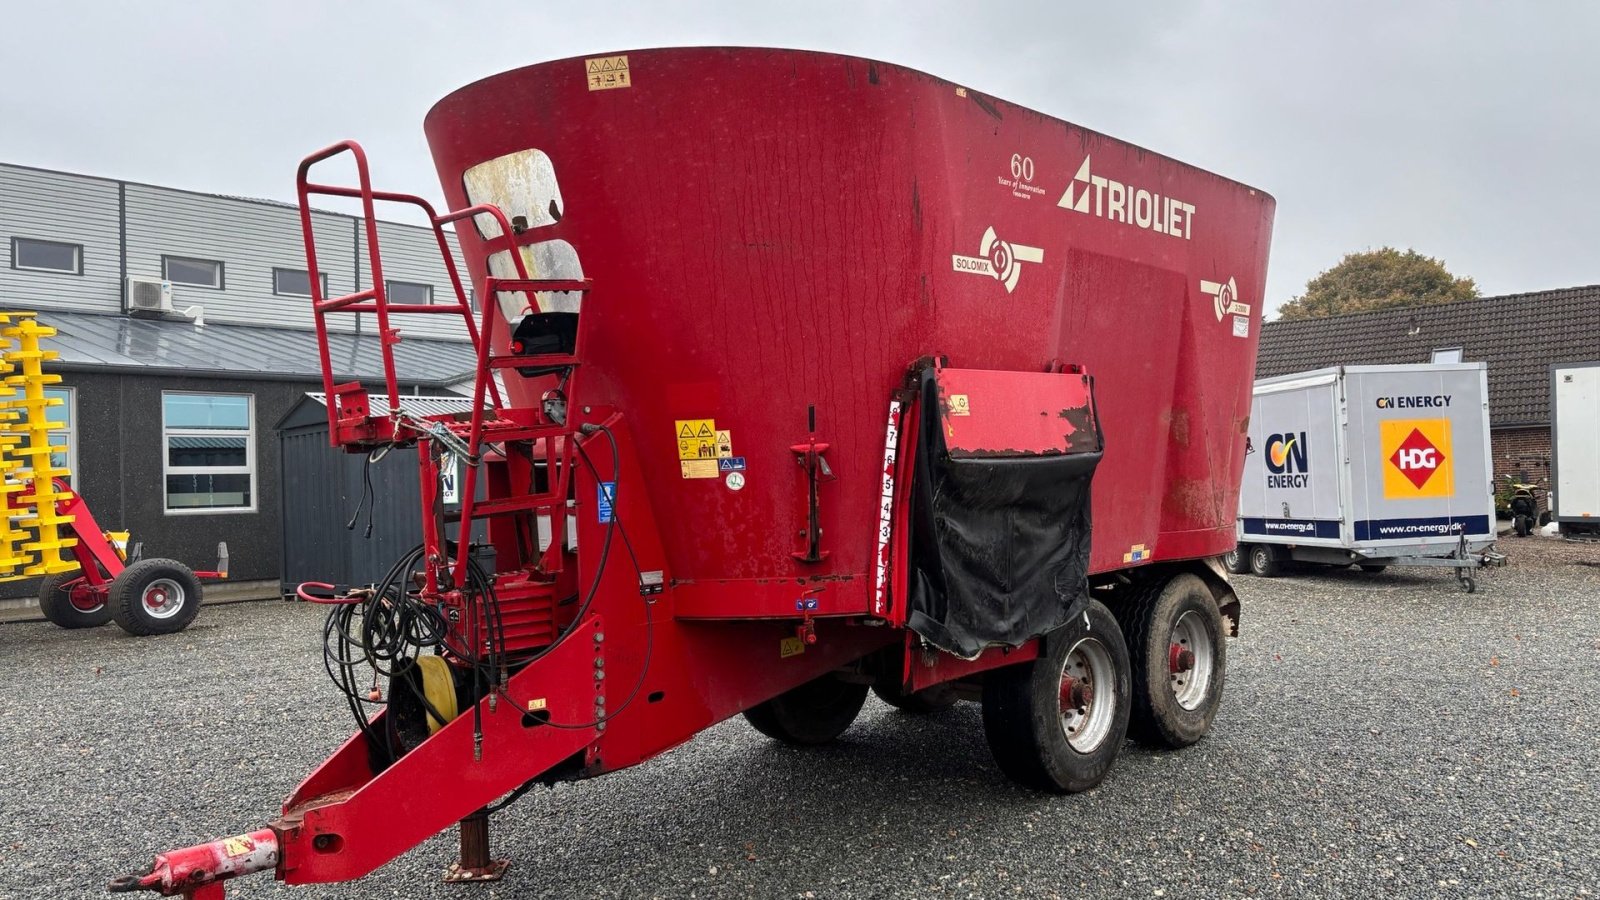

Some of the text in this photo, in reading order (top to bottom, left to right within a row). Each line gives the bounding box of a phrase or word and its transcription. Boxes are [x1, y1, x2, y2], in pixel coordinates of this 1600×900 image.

[1011, 153, 1034, 181] 60
[1091, 174, 1195, 240] TRIOLIET
[956, 258, 989, 272] SOLOMIX
[1376, 395, 1452, 409] CN ENERGY
[889, 431, 895, 441] 7
[1265, 431, 1309, 474] CN
[1399, 447, 1436, 470] HDG
[886, 455, 893, 464] 6
[885, 479, 891, 489] 5
[1267, 474, 1309, 488] ENERGY
[883, 503, 889, 514] 4
[882, 526, 888, 537] 3
[1265, 523, 1314, 532] www.cn-energy.dk
[1380, 522, 1462, 533] www.cn-energy.dk
